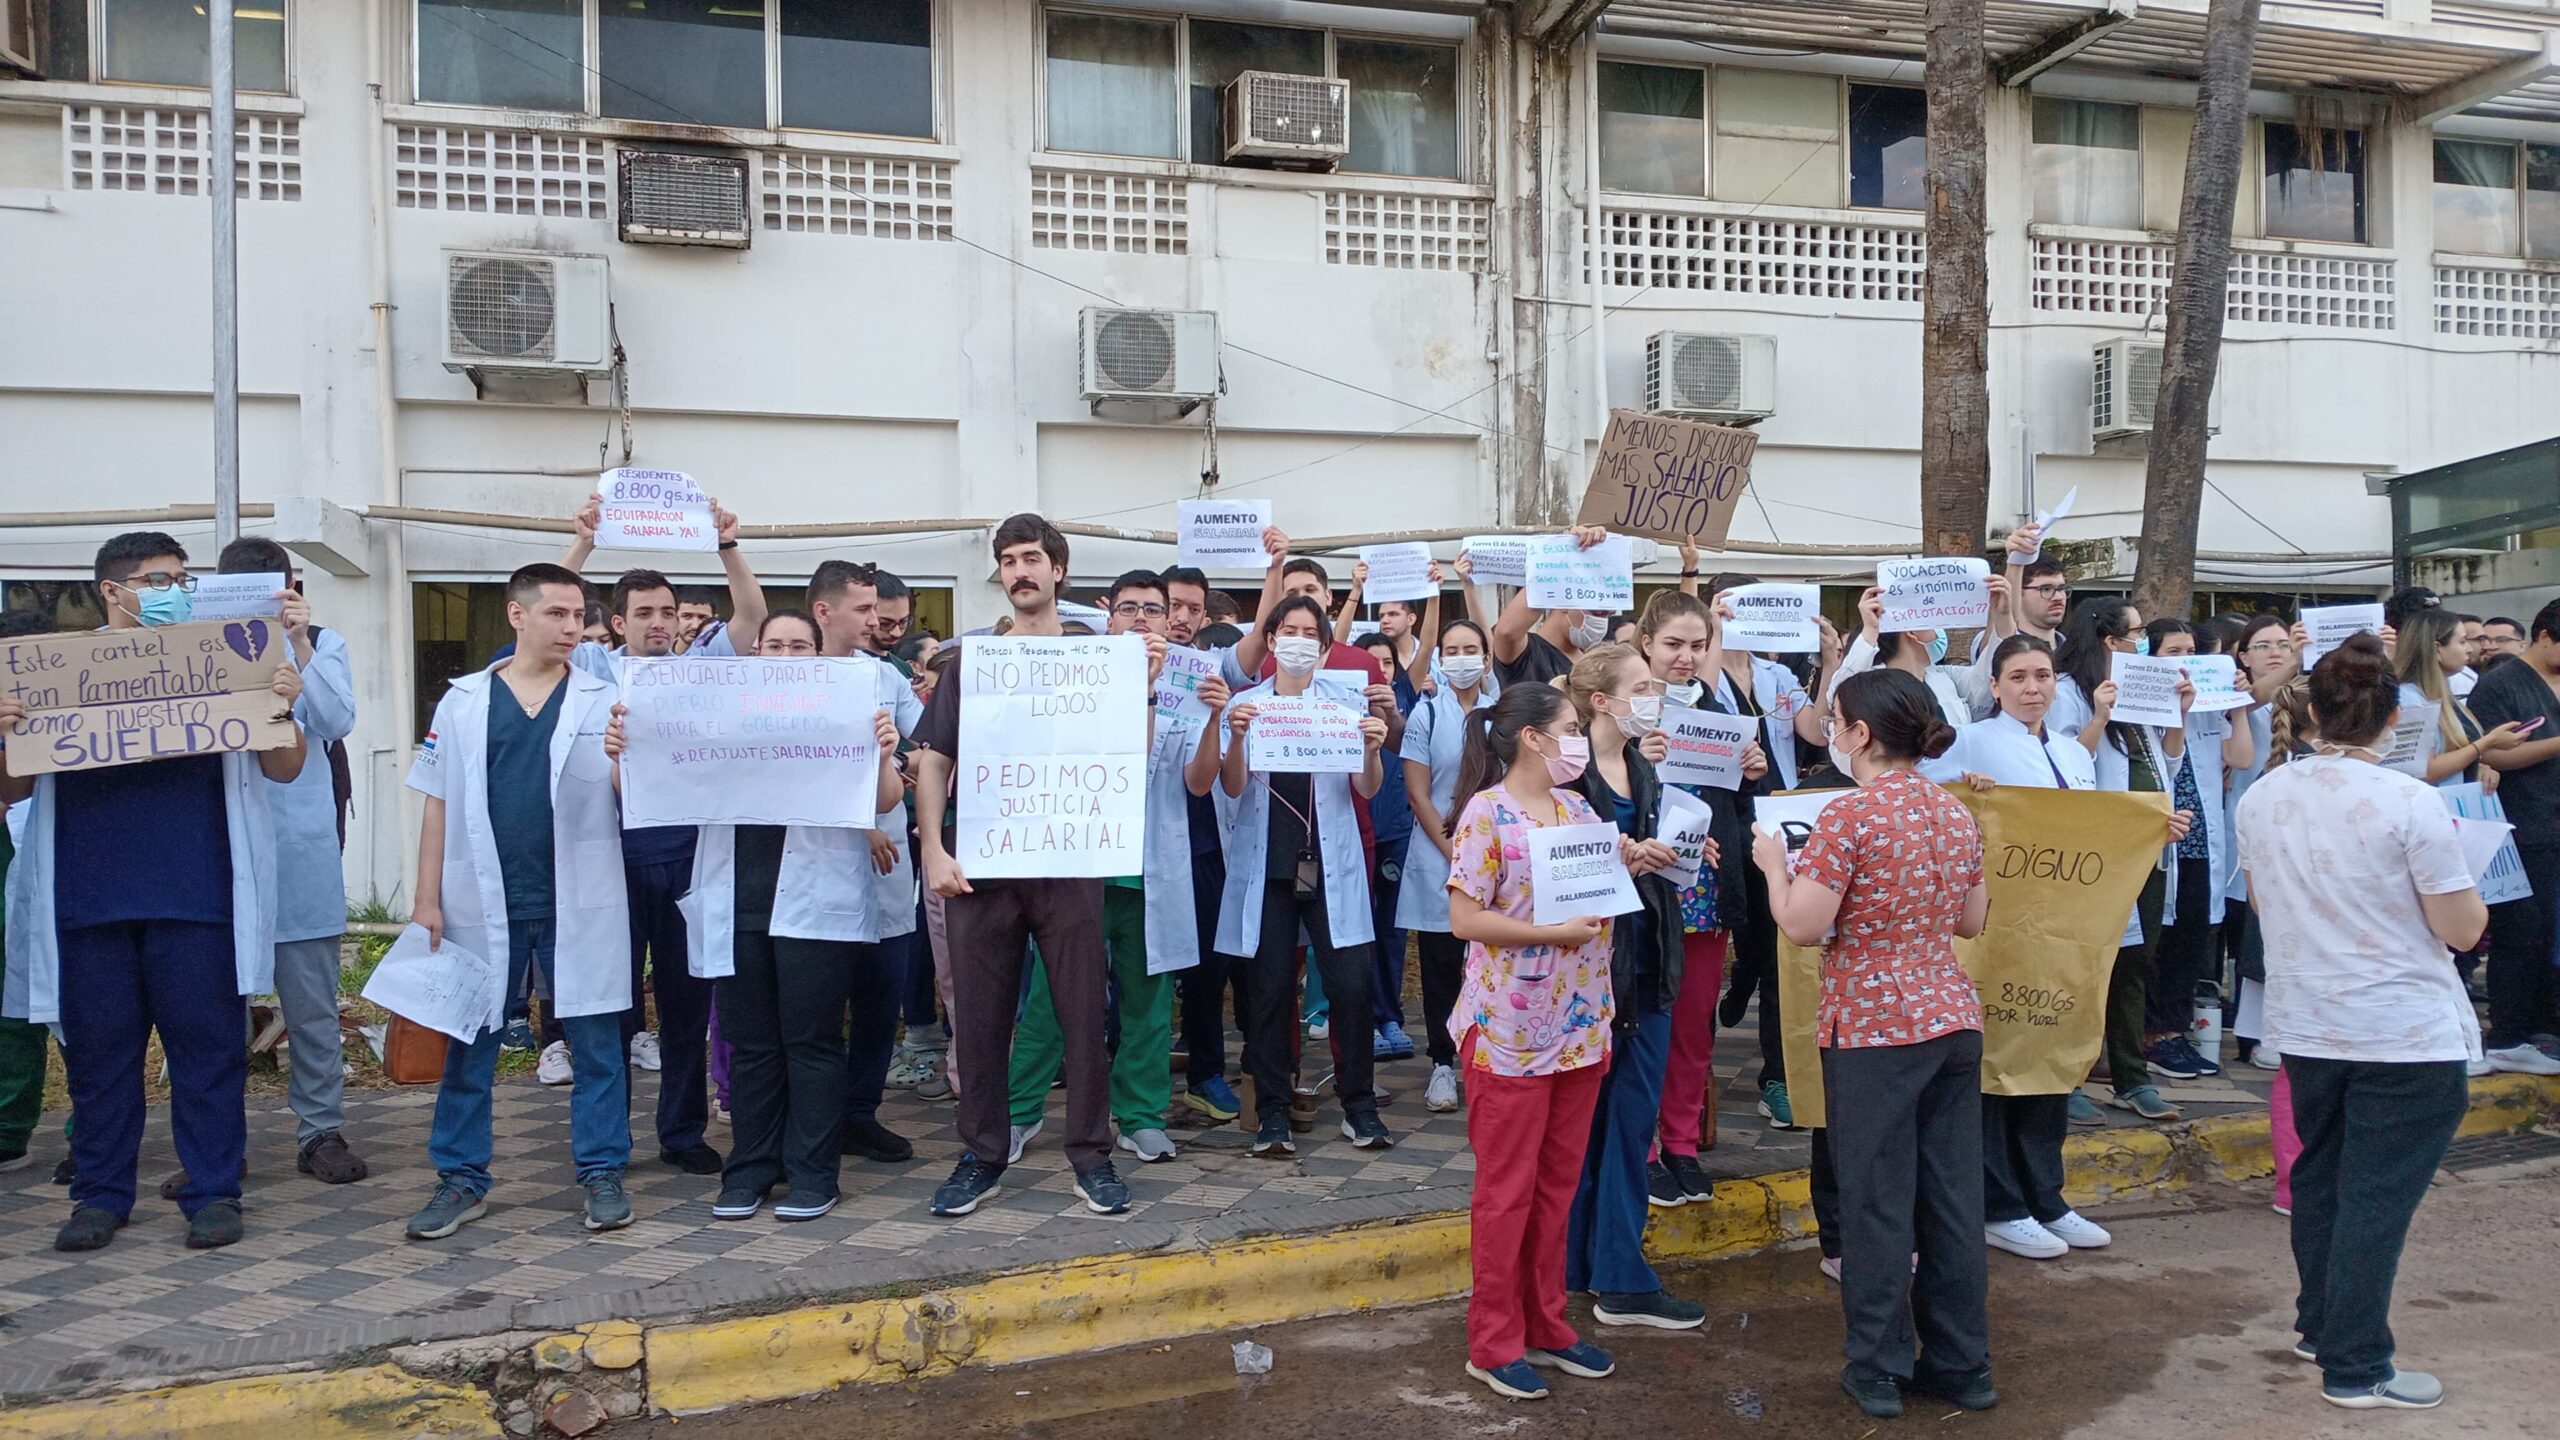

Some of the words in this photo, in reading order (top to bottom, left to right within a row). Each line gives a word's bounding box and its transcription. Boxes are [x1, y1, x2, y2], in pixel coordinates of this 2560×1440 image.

[1612, 417, 1678, 453] MENOS
[1686, 428, 1758, 468] DISCURSO
[618, 468, 683, 482] RESIDENTES
[1597, 447, 1640, 484] MÁS
[1648, 452, 1738, 501] SALARIO
[614, 481, 660, 499] 8.800
[1194, 514, 1258, 524] AUMENTO
[1615, 484, 1709, 537] JUSTO
[623, 525, 674, 537] SALARIAL
[1193, 527, 1259, 539] SALARIAL
[1888, 561, 1967, 578] VOCACIÓN
[1888, 584, 1903, 596] es
[1914, 580, 1976, 594] sinónimo
[1737, 597, 1803, 608] AUMENTO
[1923, 596, 1935, 605] de
[1736, 610, 1803, 622] SALARIAL
[6, 645, 66, 675] Este
[92, 635, 169, 663] cartel
[200, 638, 226, 652] es
[632, 664, 749, 687] ESENCIALES
[763, 664, 807, 686] PARA
[815, 664, 836, 685] EL
[1189, 658, 1215, 675] POR
[9, 681, 59, 708] tan
[79, 655, 229, 703] lamentable
[976, 662, 1020, 693] NO
[1030, 661, 1110, 687] PEDIMOS
[653, 694, 724, 716] PUEBLO
[1031, 692, 1097, 717] LUJOS
[1260, 702, 1304, 712] CURSILLO
[1321, 701, 1338, 710] año
[12, 712, 83, 736] como
[107, 700, 208, 730] nuestro
[656, 720, 698, 739] PARA
[706, 720, 727, 737] EL
[742, 715, 829, 734] GOBIERNO
[1322, 716, 1329, 724] 6
[1329, 715, 1348, 725] años
[51, 718, 249, 766] SUELDO
[1339, 730, 1358, 740] años
[1676, 723, 1742, 743] AUMENTO
[1670, 738, 1734, 757] SALARIAL
[1666, 760, 1725, 773] #SALARIODIGNOYA
[976, 763, 1129, 794] PEDIMOS
[1000, 794, 1101, 818] JUSTICIA
[980, 822, 1126, 859] SALARIAL
[1550, 841, 1612, 860] AUMENTO
[1552, 860, 1613, 881] SALARIAL
[1555, 887, 1617, 903] #SALARIODIGNOYA
